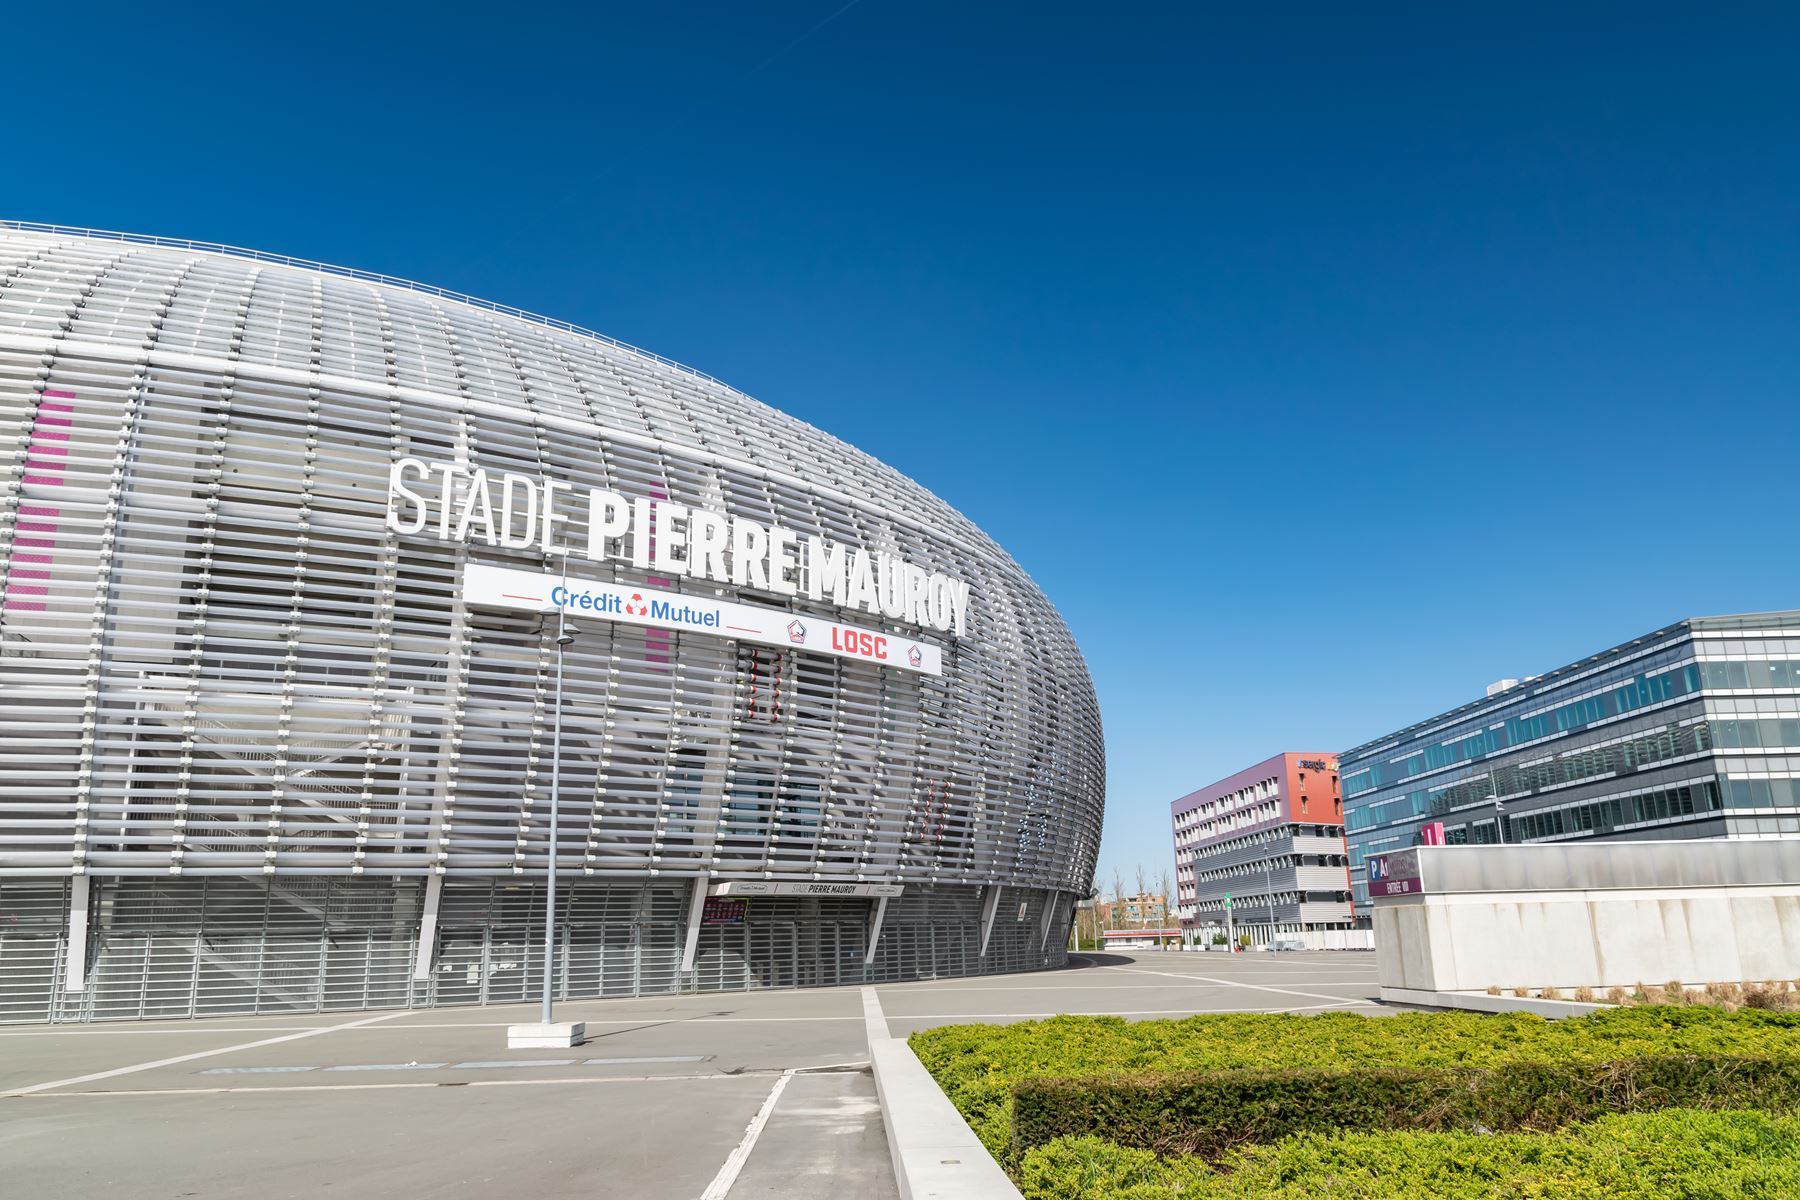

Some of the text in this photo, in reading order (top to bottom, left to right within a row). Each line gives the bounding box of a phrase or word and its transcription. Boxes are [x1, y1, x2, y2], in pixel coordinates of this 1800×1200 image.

[386, 458, 970, 637] STADE PIERRE MAUROY
[551, 586, 720, 627] Crédit Mutuel
[832, 626, 888, 659] LOSC
[808, 884, 831, 894] PIERRE
[831, 885, 856, 894] MAUROY
